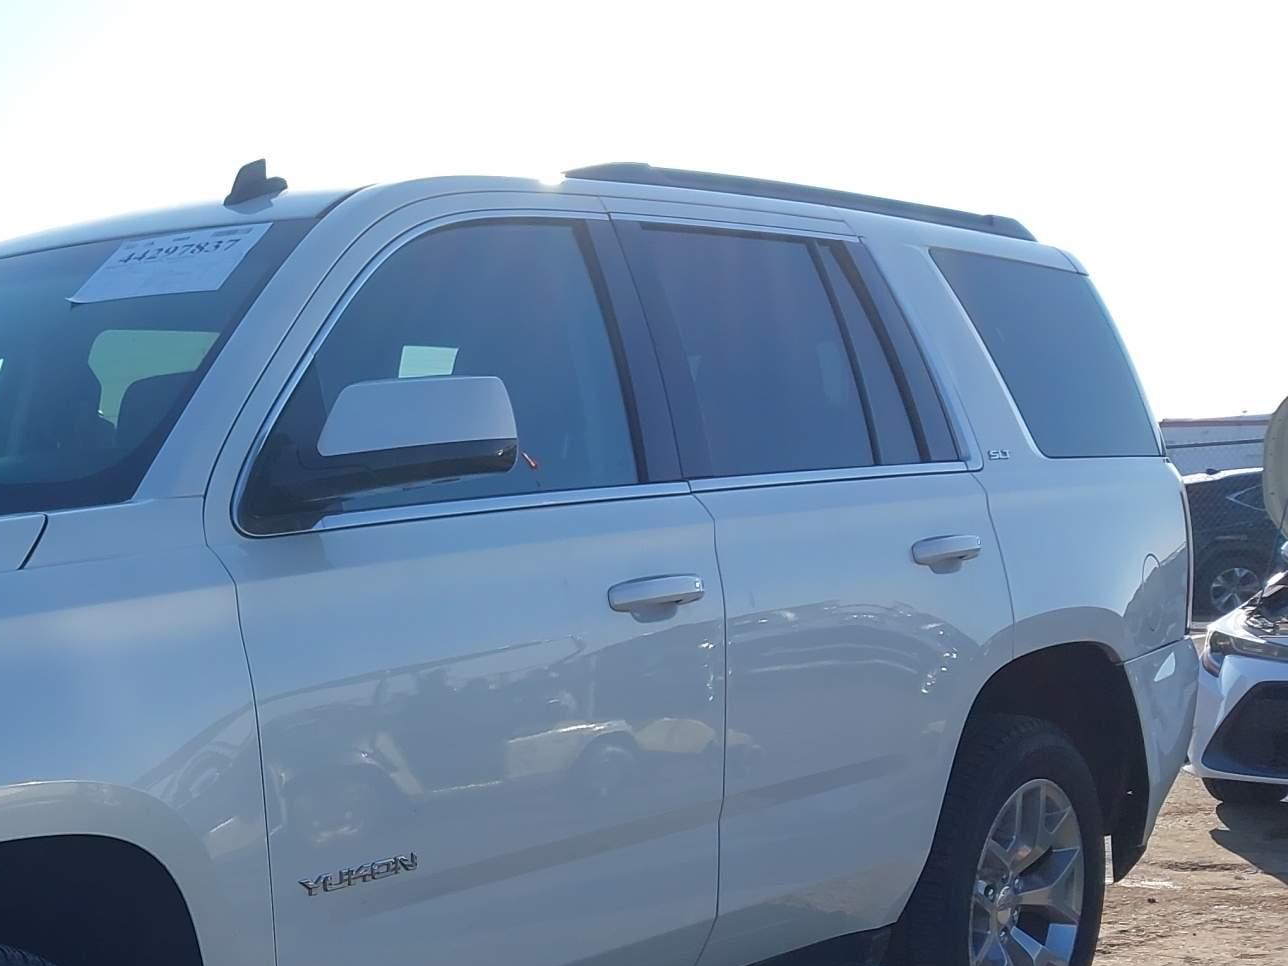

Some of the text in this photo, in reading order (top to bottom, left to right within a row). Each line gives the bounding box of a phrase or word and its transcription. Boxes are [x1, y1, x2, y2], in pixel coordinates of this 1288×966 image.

[120, 239, 241, 263] 44297837
[987, 449, 1010, 460] SLT
[297, 852, 418, 896] YUKON
